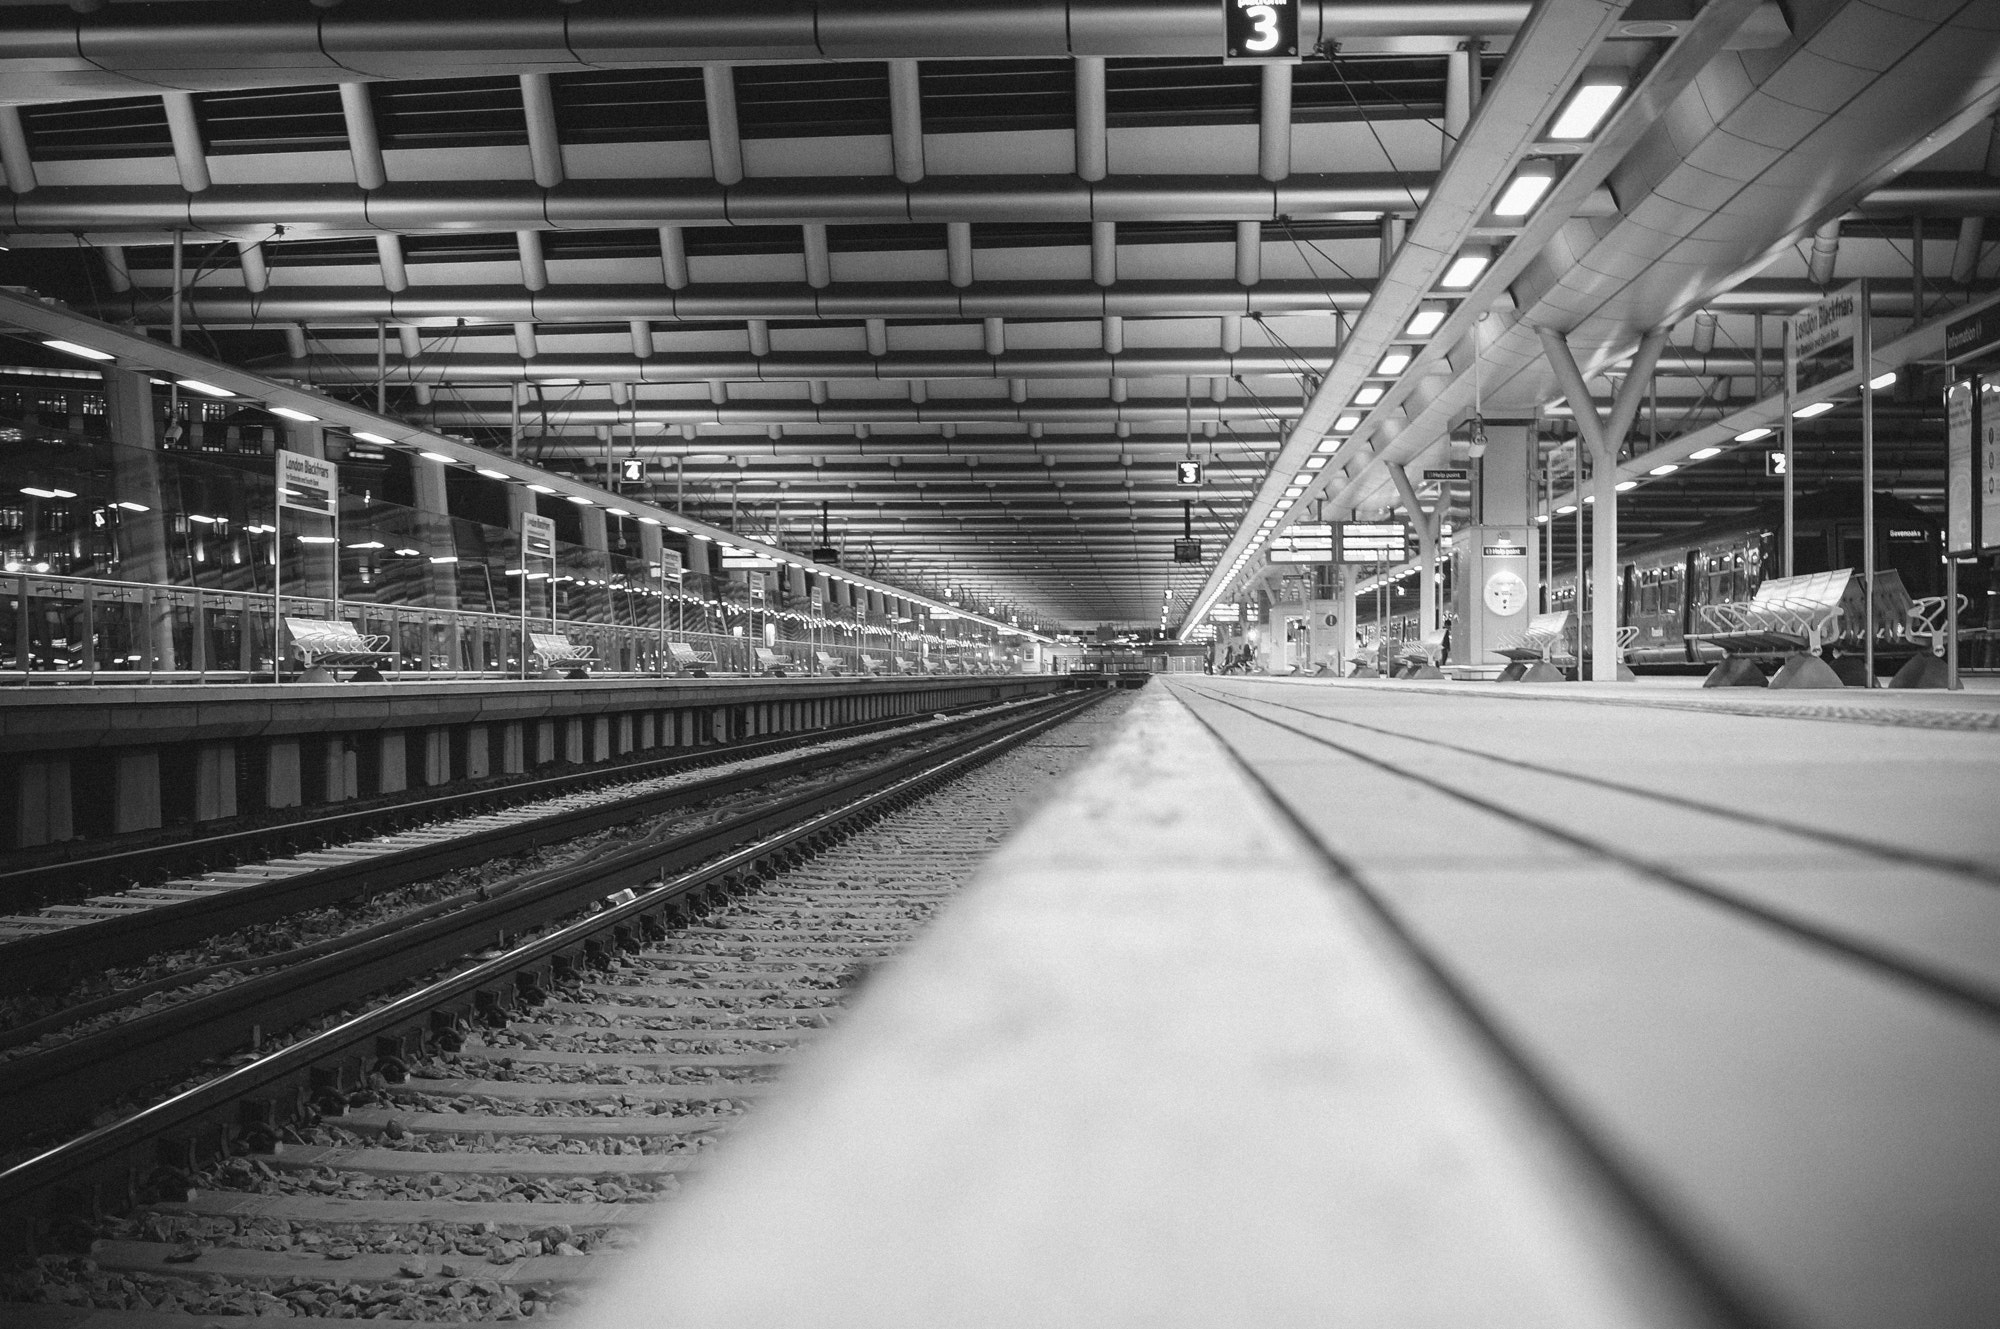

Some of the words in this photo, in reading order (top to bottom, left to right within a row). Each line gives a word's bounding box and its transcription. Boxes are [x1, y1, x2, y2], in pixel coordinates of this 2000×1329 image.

[1245, 5, 1279, 51] 3
[1795, 313, 1818, 340] London
[1818, 295, 1854, 329] Blackfriars
[1947, 326, 1976, 349] Information
[285, 455, 304, 472] London
[304, 460, 329, 478] Blackfriars
[626, 464, 640, 480] 4
[1774, 456, 1786, 474] 2
[1183, 466, 1196, 483] 3
[1432, 471, 1446, 479] Help
[1889, 529, 1922, 538] Sevenoaks
[1492, 547, 1506, 555] Help
[1506, 548, 1521, 556] point
